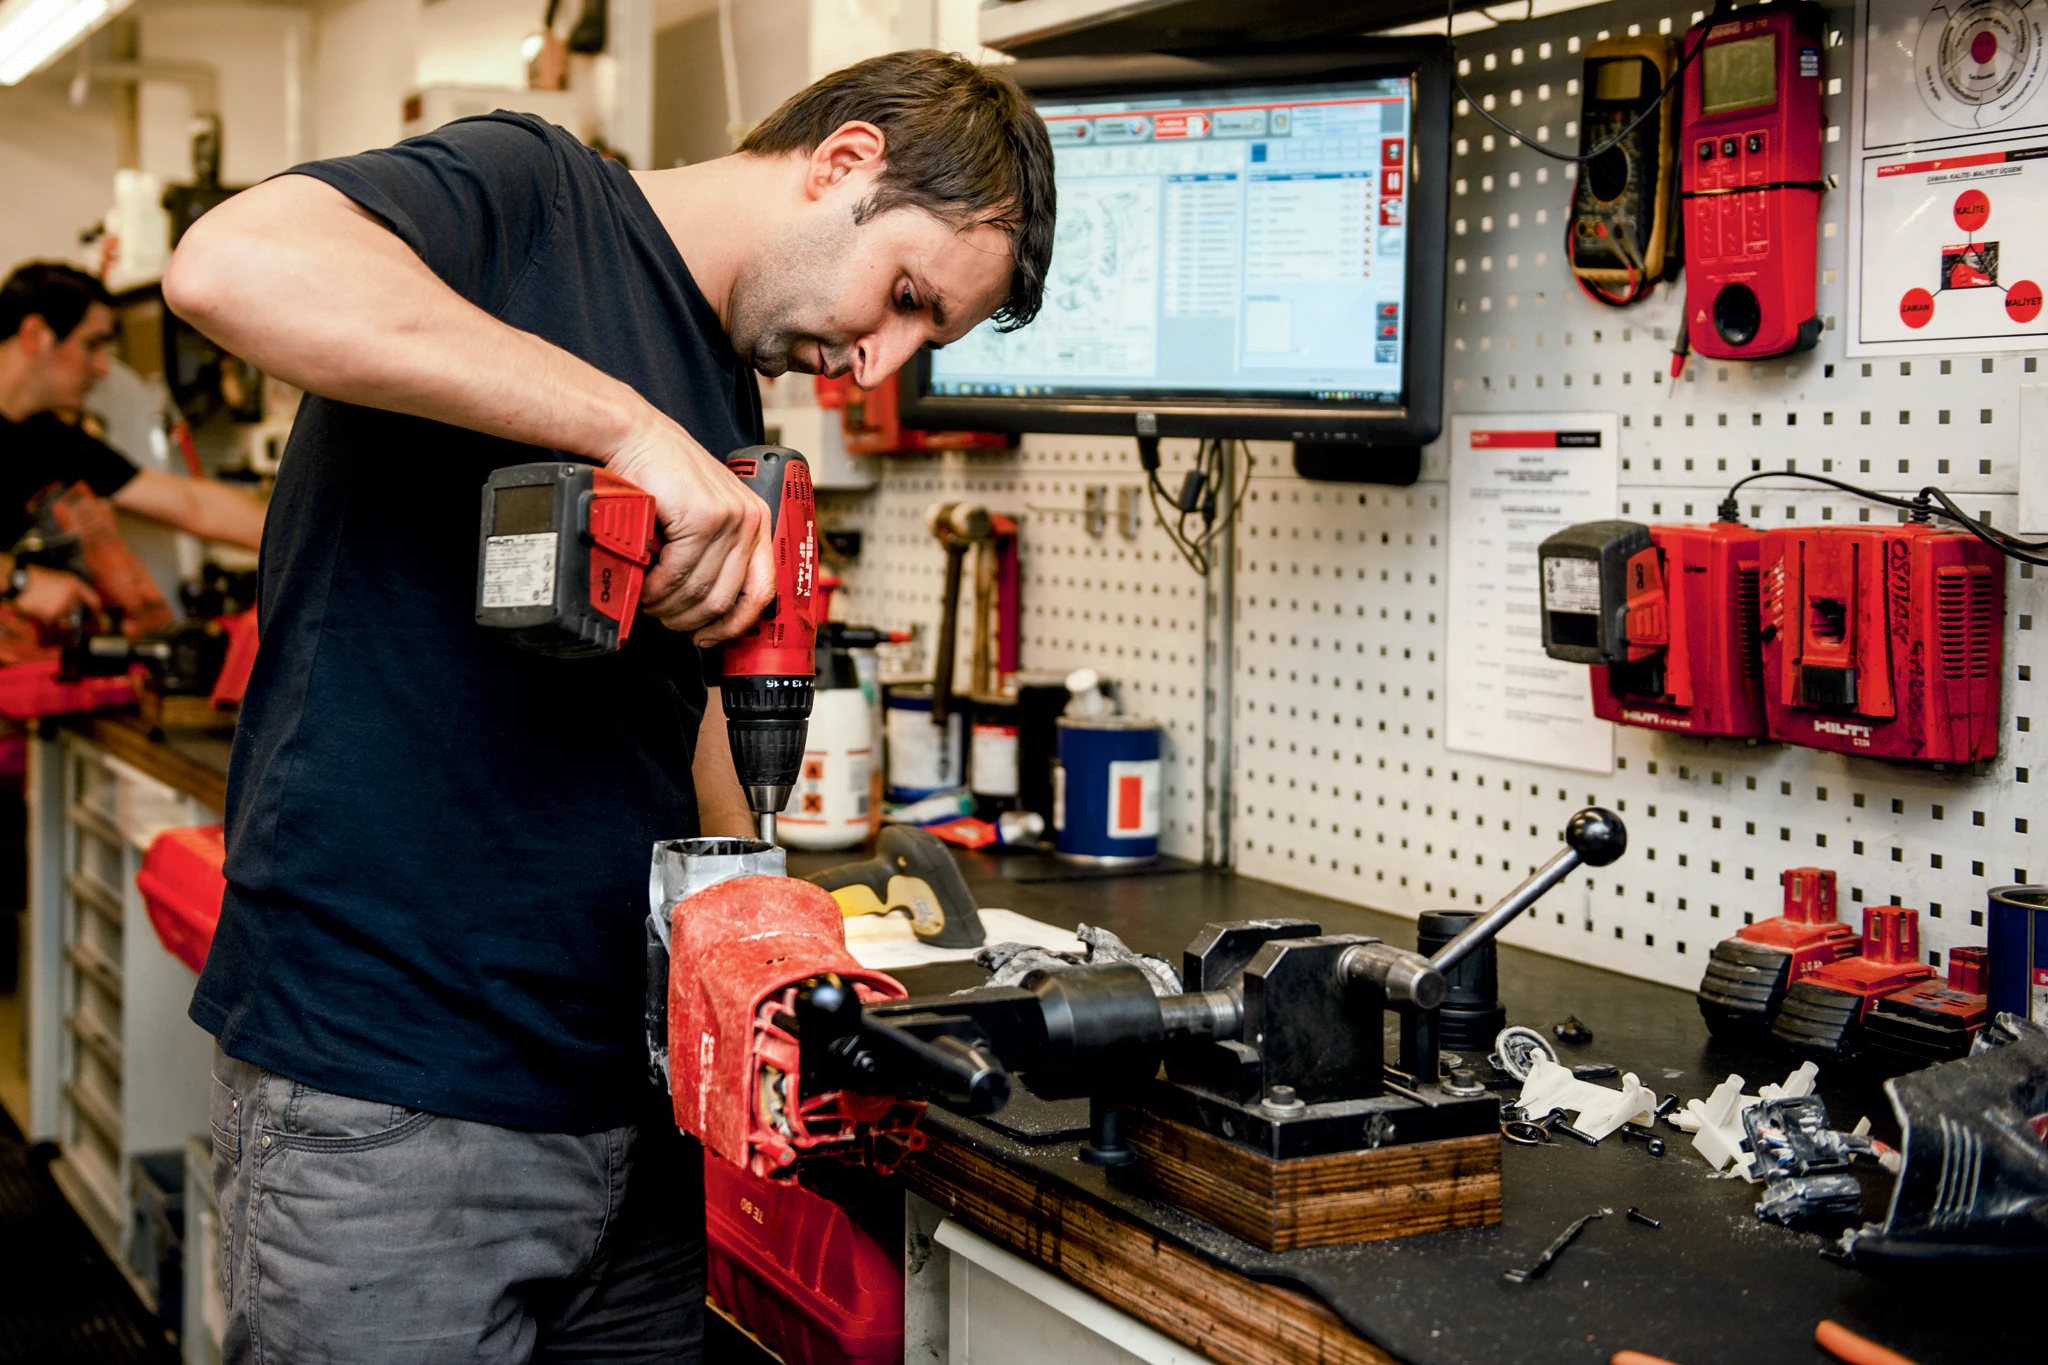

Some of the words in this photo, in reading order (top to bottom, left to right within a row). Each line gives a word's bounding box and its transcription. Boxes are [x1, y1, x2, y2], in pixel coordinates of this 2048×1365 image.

[799, 541, 806, 558] SF
[803, 520, 814, 597] HILTI
[601, 567, 612, 603] CPC
[796, 561, 805, 596] 144-A
[1636, 562, 1645, 590] CPC
[765, 679, 780, 688] 15
[791, 679, 803, 688] 13
[1622, 710, 1659, 725] HILTI
[1813, 719, 1870, 738] HILTI
[752, 1205, 764, 1225] TE
